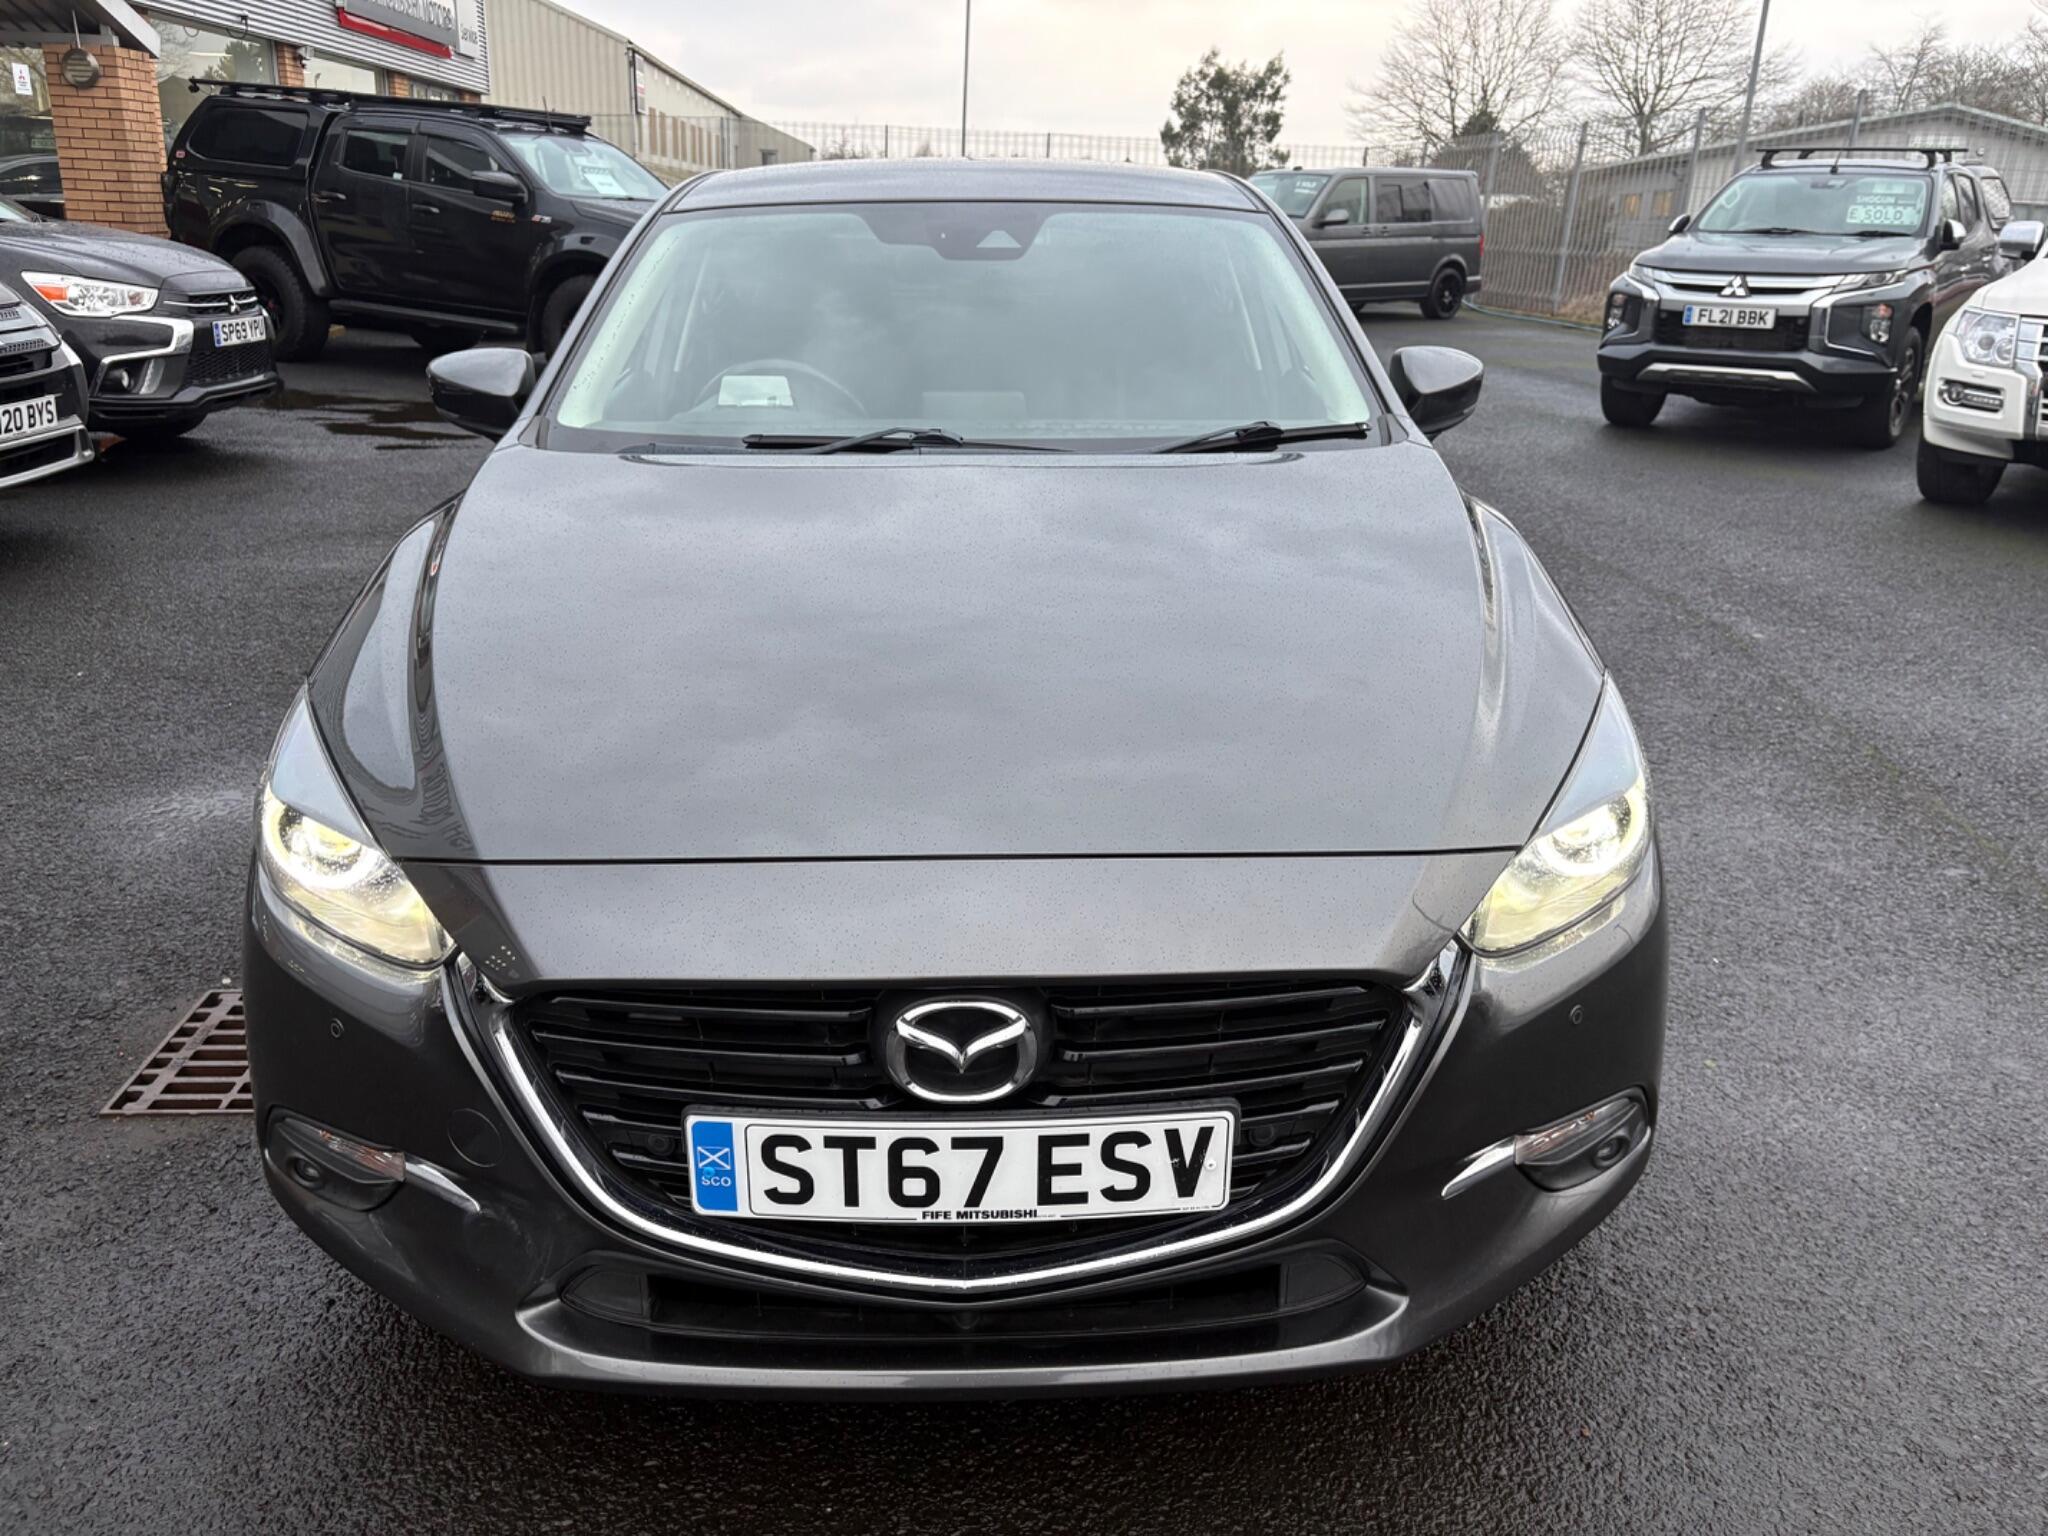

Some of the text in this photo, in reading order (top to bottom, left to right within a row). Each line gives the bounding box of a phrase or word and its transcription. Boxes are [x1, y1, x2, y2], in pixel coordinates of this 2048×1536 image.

[1863, 208, 1904, 221] SOLD
[1697, 308, 1769, 326] FL21 BBK
[221, 321, 248, 343] SP69
[0, 400, 54, 436] 20 BYS
[760, 1126, 1215, 1208] ST67 ESV
[702, 1175, 732, 1187] SCO
[921, 1210, 952, 1220] FIFE
[955, 1208, 1038, 1220] MITSUBISHI
